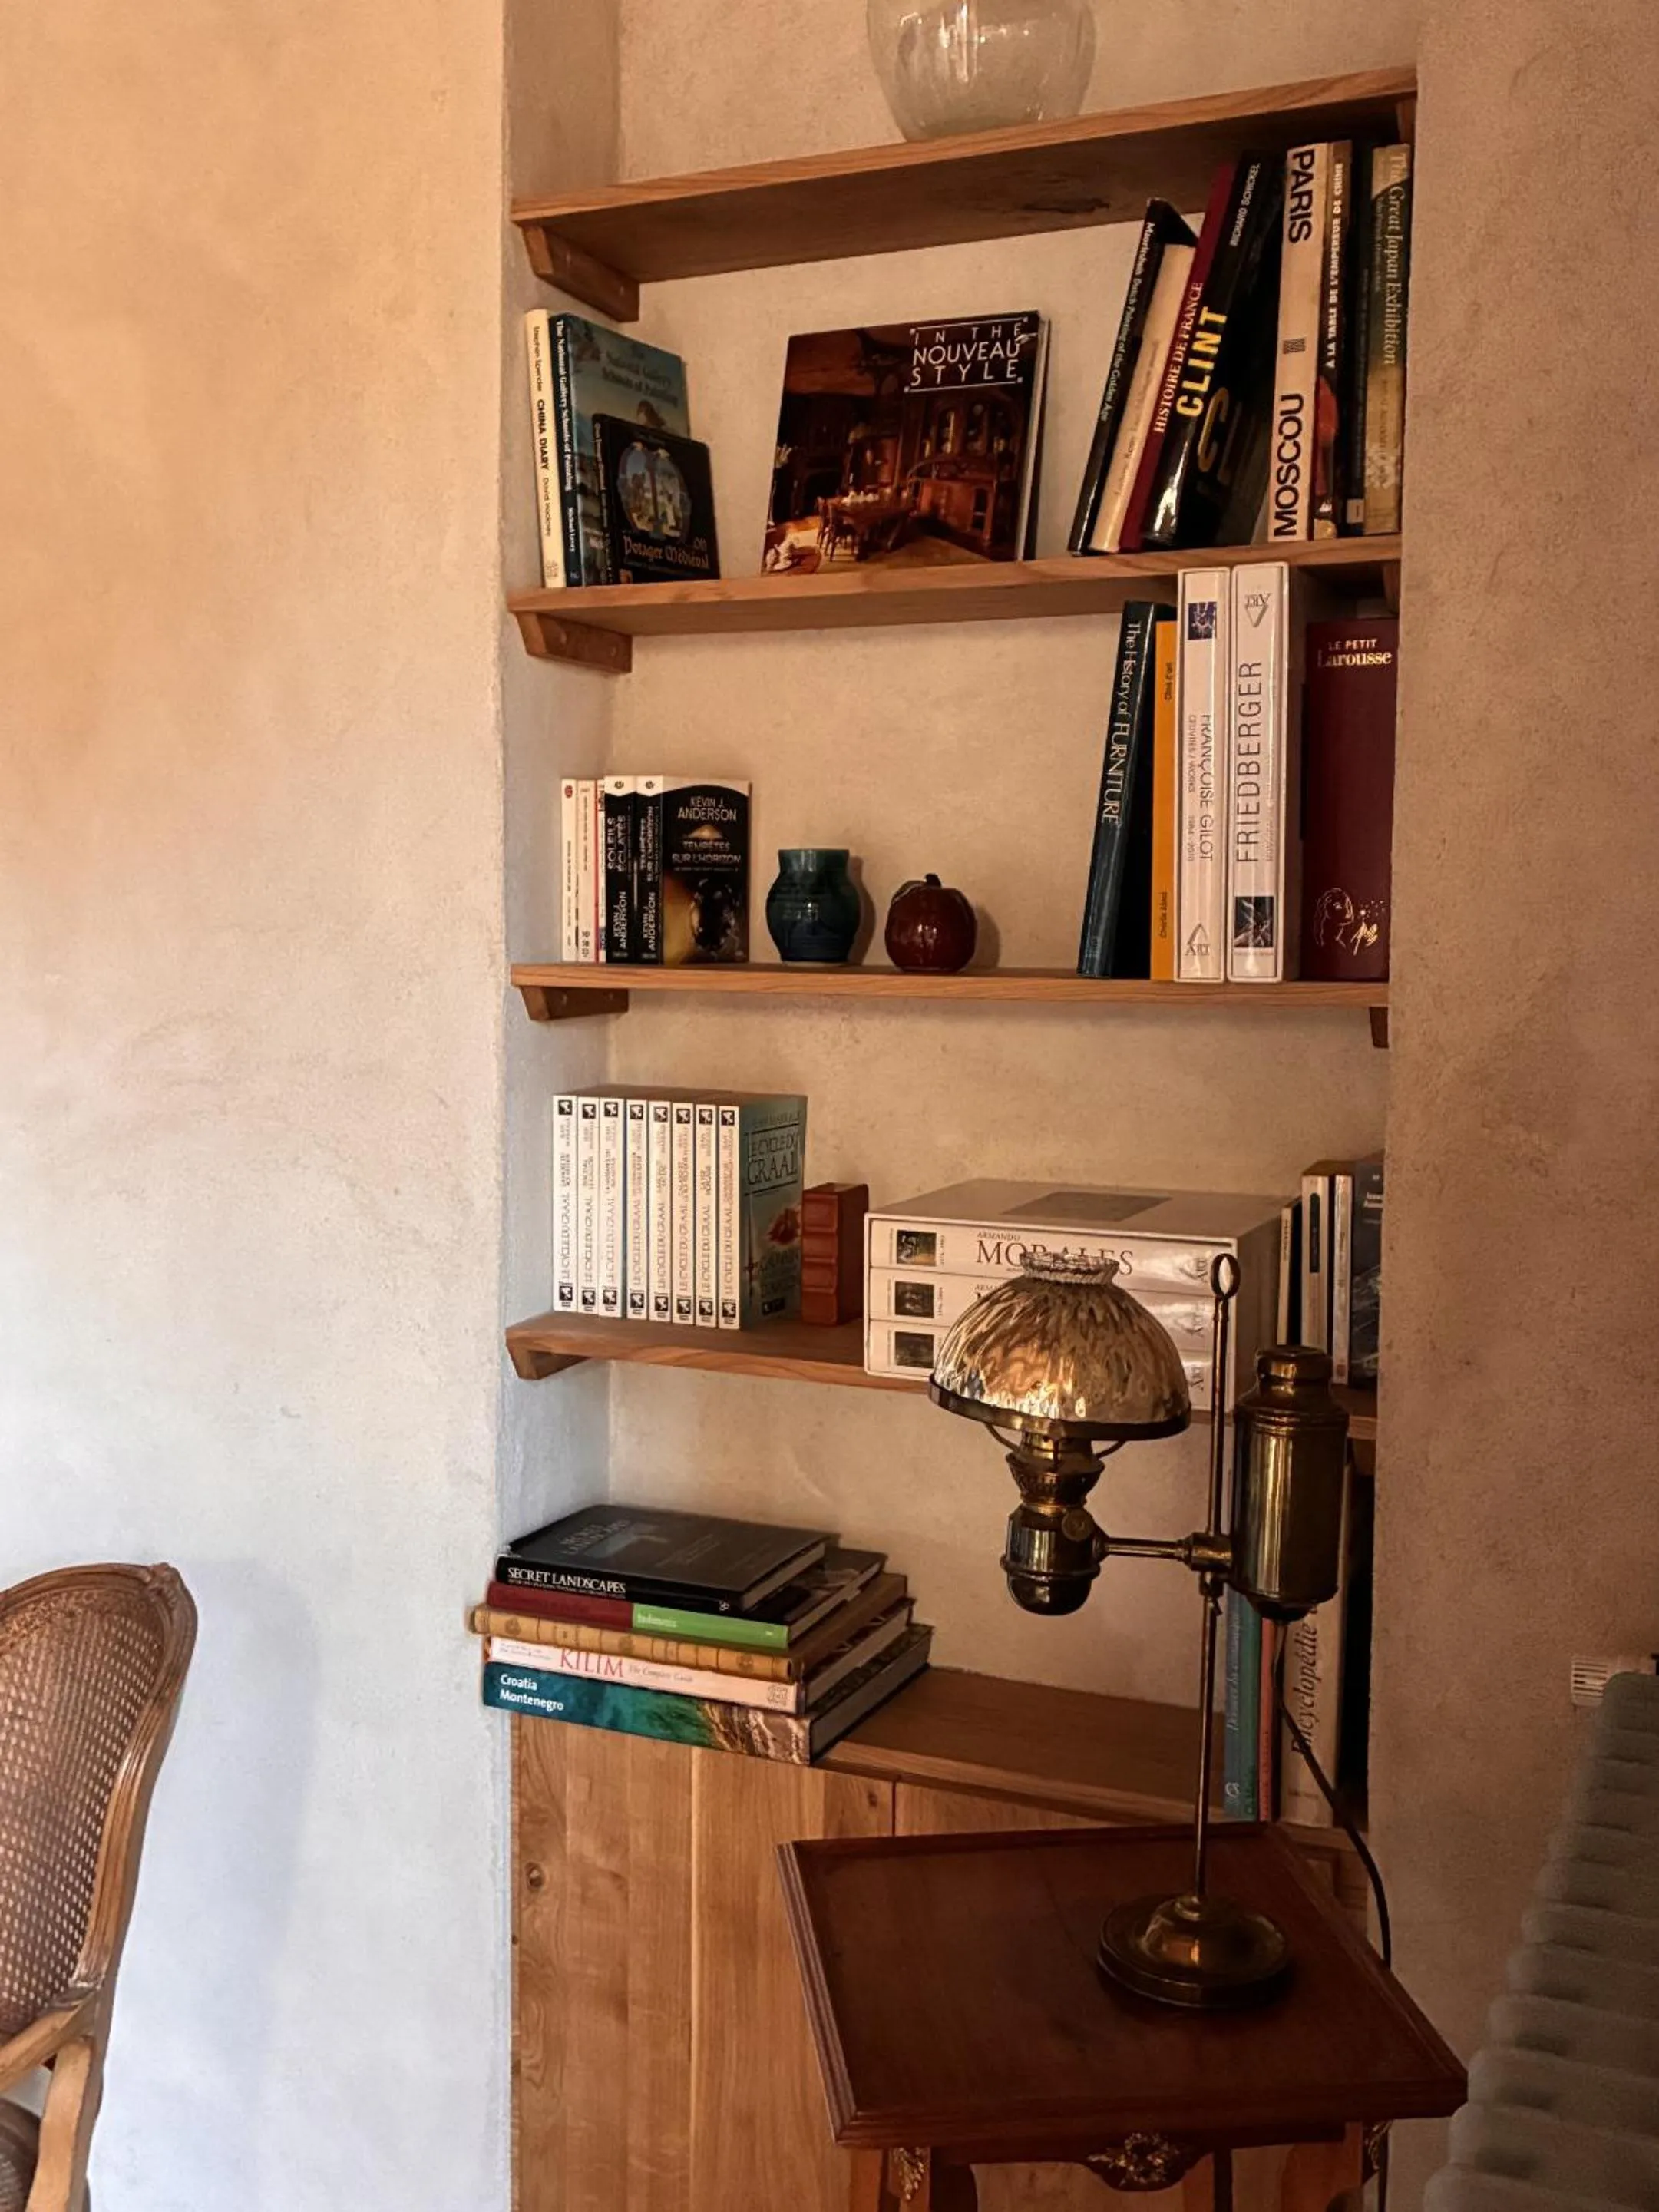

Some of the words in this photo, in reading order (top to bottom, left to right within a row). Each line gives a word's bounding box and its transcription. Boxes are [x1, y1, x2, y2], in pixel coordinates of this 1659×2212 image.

[1288, 149, 1315, 244] PARIS
[1331, 199, 1342, 214] DE
[1387, 186, 1406, 231] Great
[1382, 233, 1404, 279] Japan
[1178, 282, 1203, 339] FRANCE
[1327, 288, 1339, 303] DE
[915, 330, 946, 346] IN
[971, 322, 1021, 341] THE
[1383, 282, 1403, 365] Exhibition
[913, 339, 1020, 366] NOUVEAU
[1174, 342, 1188, 362] DE
[1176, 306, 1227, 417] CLINT
[1325, 342, 1337, 356] LA
[910, 359, 1019, 387] STYLE
[1153, 364, 1182, 434] HISTOIRE
[537, 398, 547, 435] CHINA
[540, 438, 550, 470] DIARY
[1274, 393, 1304, 537] MOSCOU
[1124, 620, 1142, 651] The
[1329, 641, 1341, 650] LE
[1345, 638, 1378, 649] PETIT
[1317, 650, 1393, 667] Larousse
[1115, 650, 1138, 701] History
[1115, 699, 1130, 716] of
[1100, 721, 1131, 825] FURNITURE
[1200, 714, 1214, 808] FRANÇOISE
[1237, 662, 1262, 862] FRIEDBERGER
[678, 807, 737, 822] ANDERSON
[690, 795, 716, 808] KEVIN
[606, 816, 617, 870] SOLEILS
[1199, 815, 1215, 861] GILOT
[618, 891, 628, 950] ANDERSON
[647, 891, 656, 951] ANDERSON
[747, 1151, 798, 1185] GRAAL
[976, 1231, 1021, 1242] ARMANDO
[507, 1567, 550, 1584] SECRET
[553, 1572, 626, 1594] LANDSCAPES
[560, 1648, 624, 1678] KILIM
[500, 1674, 537, 1691] Croatia
[499, 1690, 564, 1711] Montenegro
